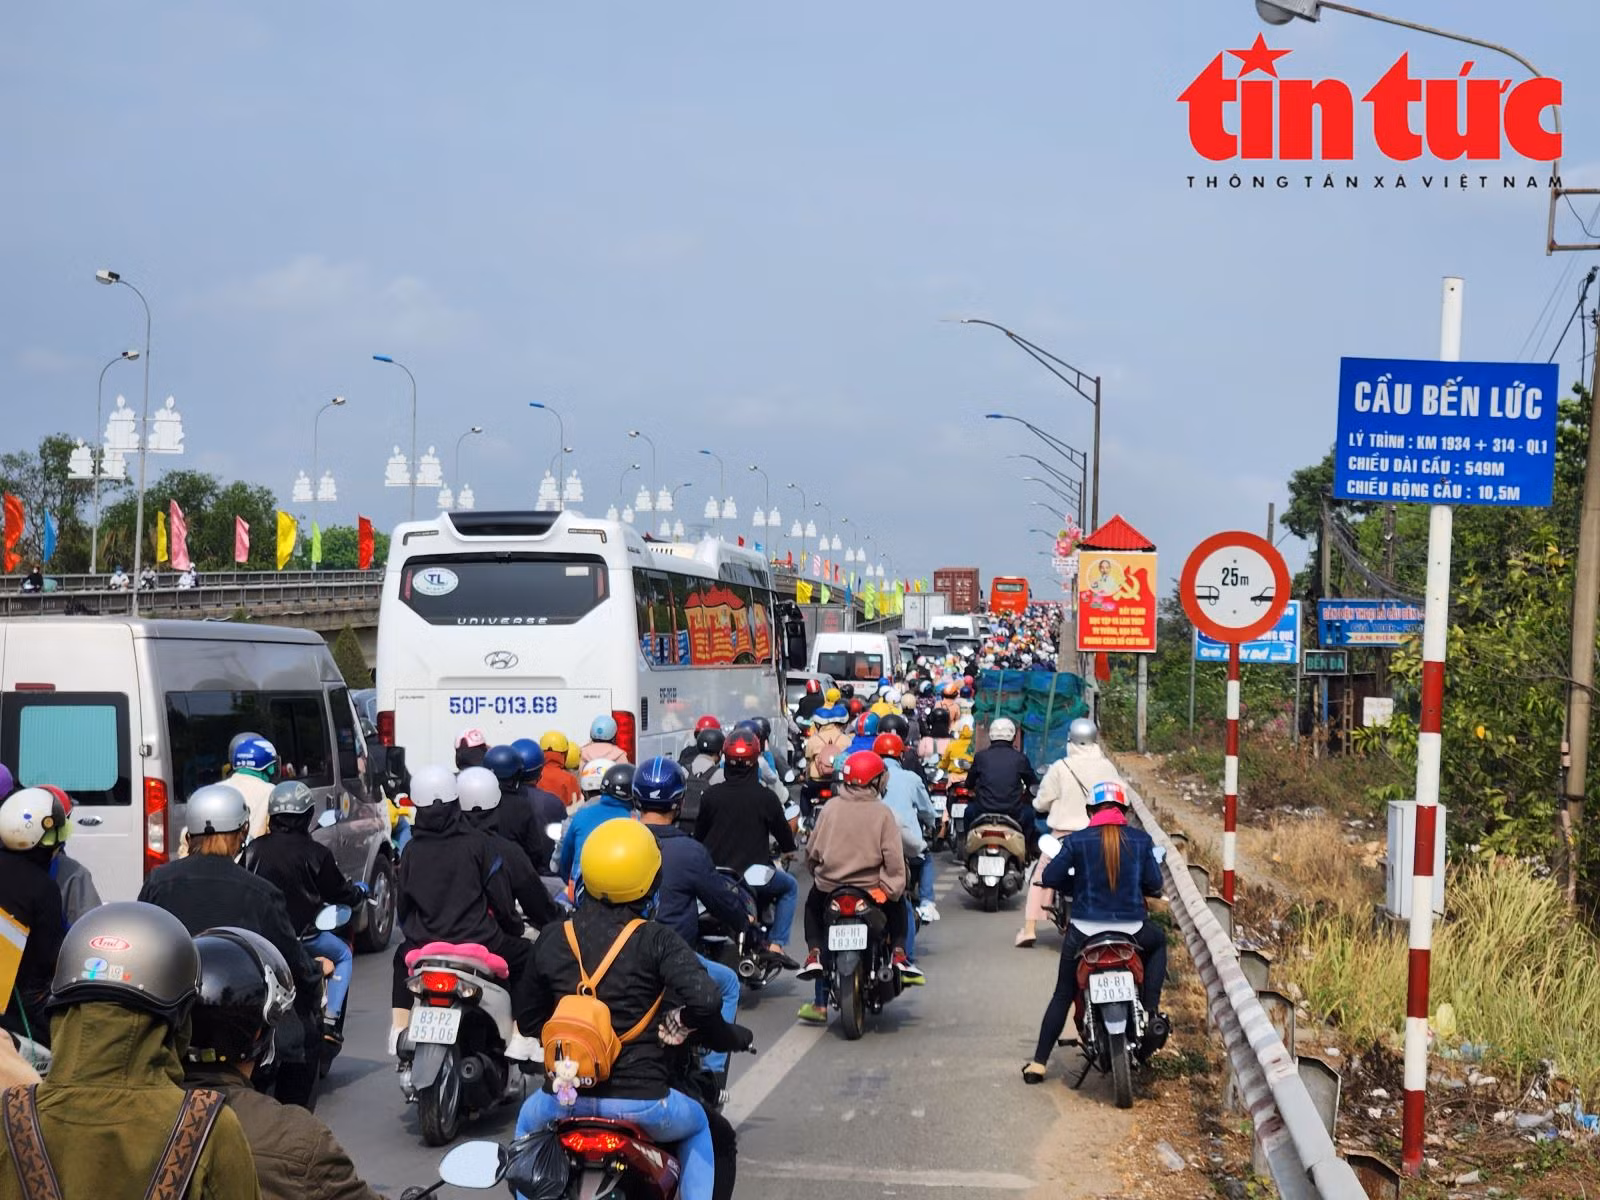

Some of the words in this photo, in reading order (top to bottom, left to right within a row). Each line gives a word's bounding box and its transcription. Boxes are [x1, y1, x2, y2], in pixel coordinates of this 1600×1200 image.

[1354, 373, 1412, 414] CẦU
[1422, 376, 1480, 417] BẾN
[1490, 380, 1543, 419] LỨC
[1349, 429, 1364, 447] LÝ
[1369, 431, 1405, 449] TRÌNH
[1416, 435, 1437, 450] KM
[1441, 436, 1471, 451] 1934
[1492, 438, 1515, 453] 314
[1526, 438, 1547, 456] QL1
[1464, 461, 1505, 476] 549M
[1392, 479, 1429, 500] RỘNG
[1478, 485, 1520, 502] 10,5M
[457, 617, 548, 625] UNIVERSE
[449, 696, 558, 714] 50F-013.68
